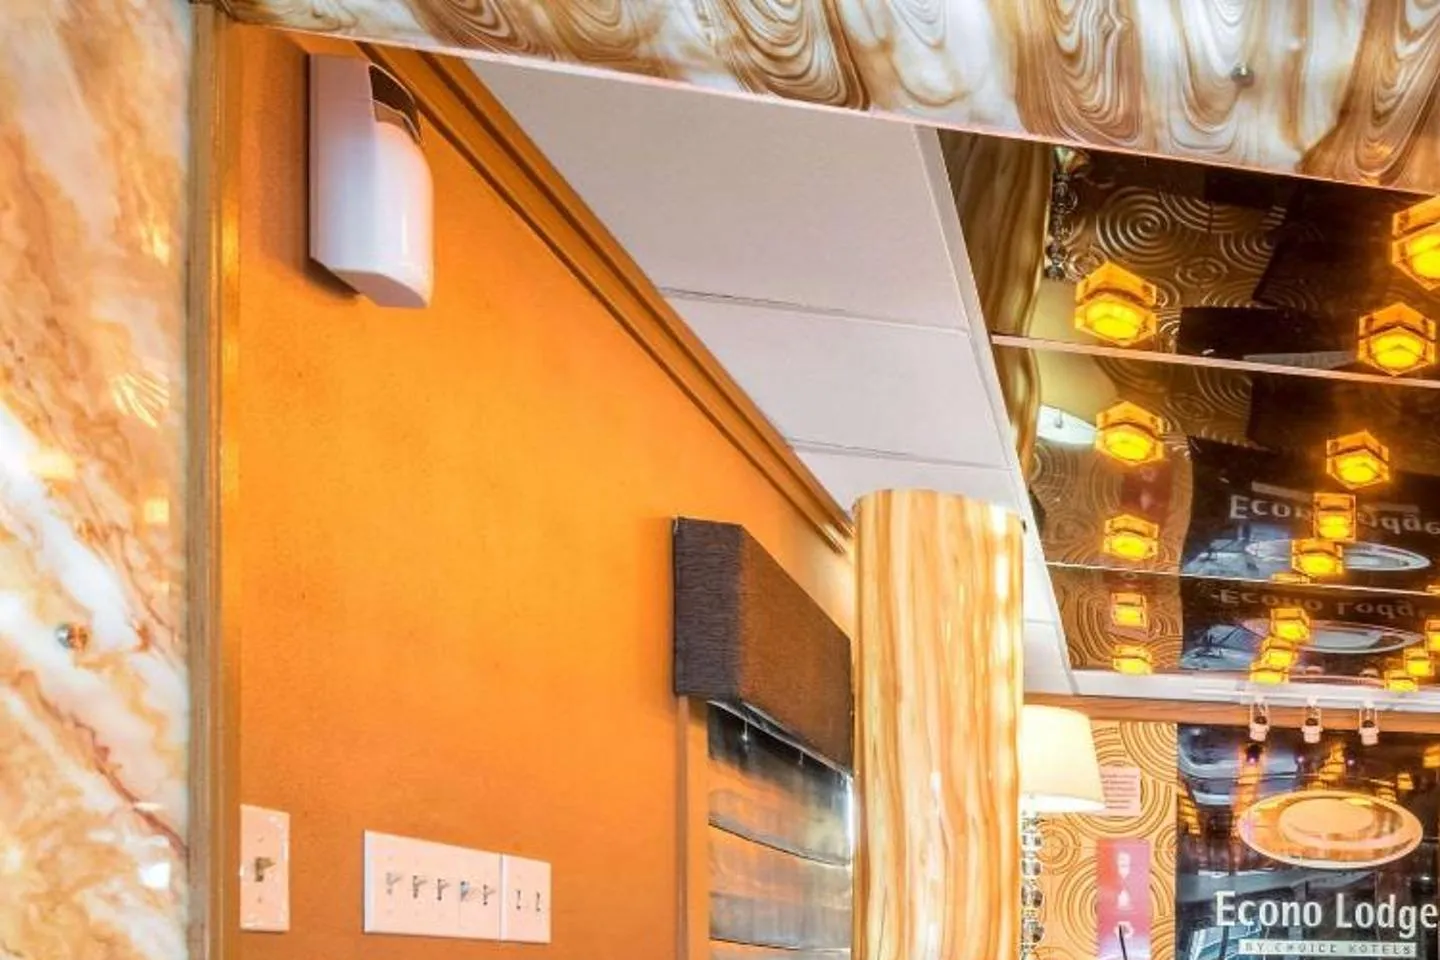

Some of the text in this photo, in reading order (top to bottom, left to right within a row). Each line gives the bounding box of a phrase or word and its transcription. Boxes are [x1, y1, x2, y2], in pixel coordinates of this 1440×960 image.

[1214, 890, 1438, 938] Econo Lodge
[1245, 942, 1411, 955] BY CHOICE HOTELS
